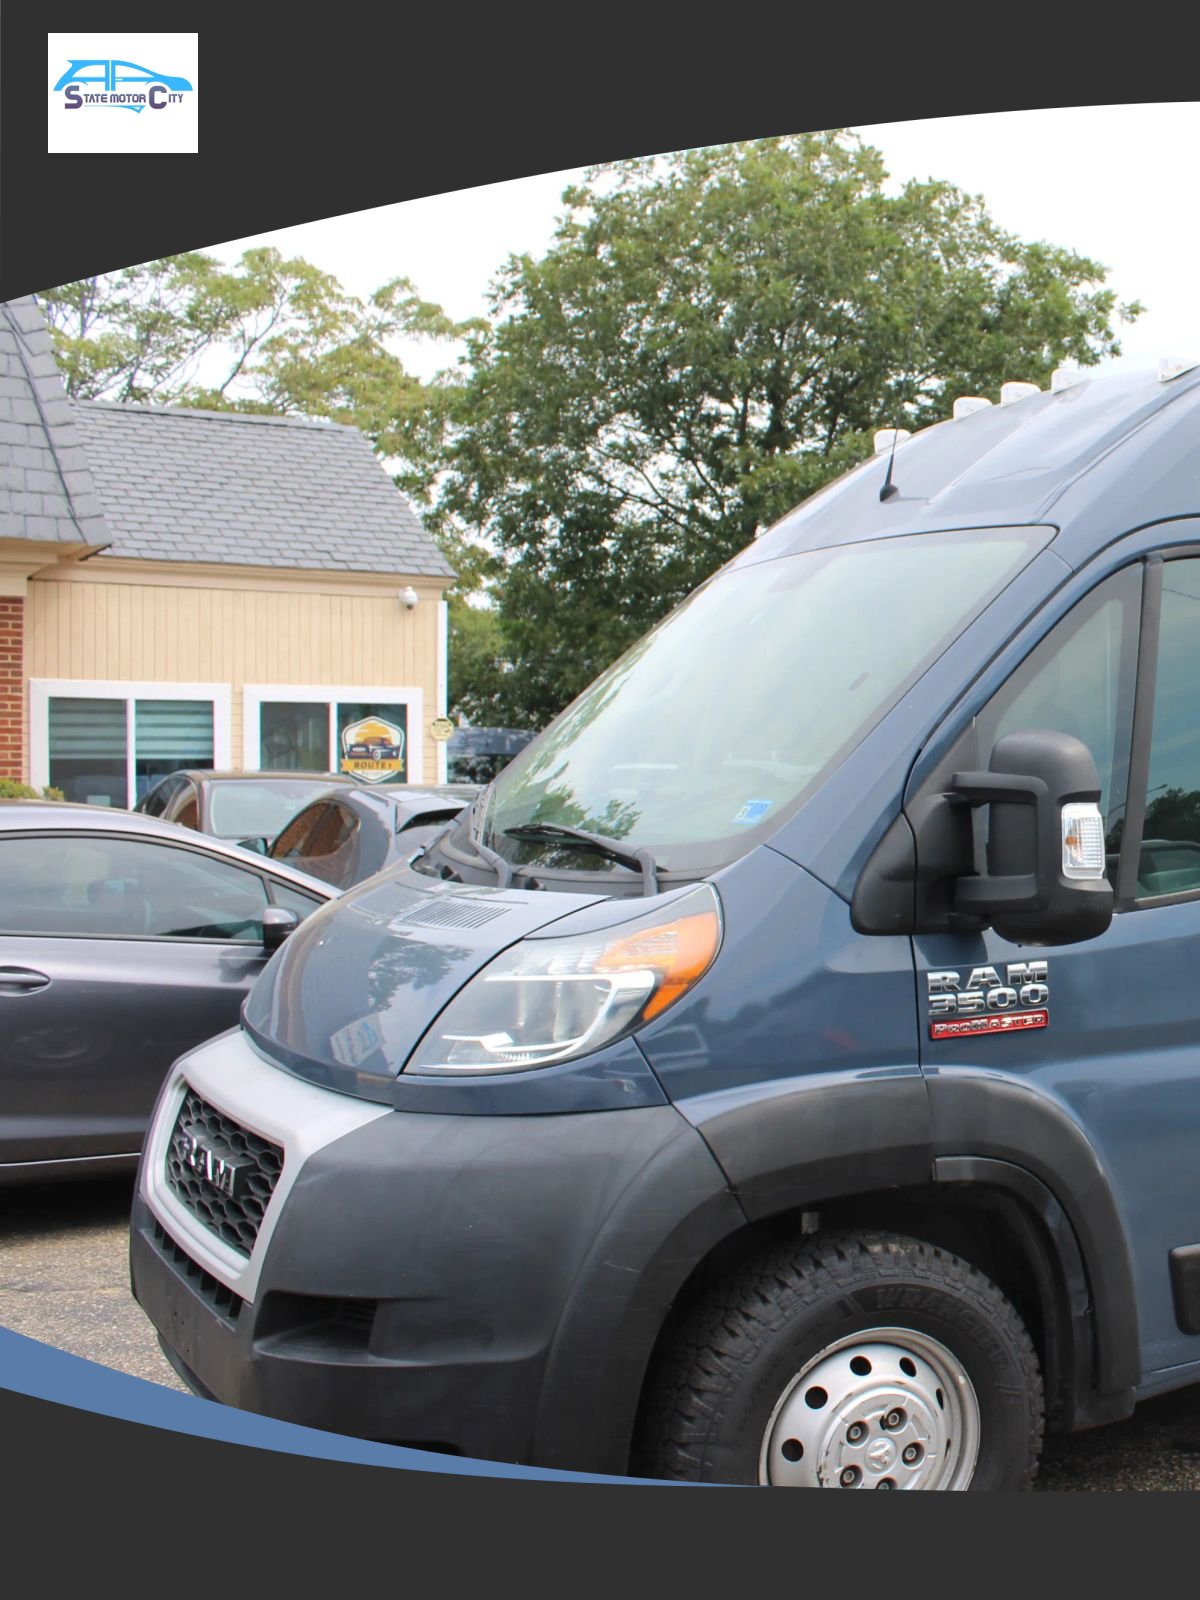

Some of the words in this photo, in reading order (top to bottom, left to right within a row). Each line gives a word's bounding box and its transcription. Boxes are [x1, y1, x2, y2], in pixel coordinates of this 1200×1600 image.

[353, 761, 386, 769] ROUTE
[926, 961, 1048, 993] RAM
[928, 984, 1049, 1016] 3500
[934, 1014, 1045, 1034] PROMASTER
[182, 1130, 236, 1198] RAM
